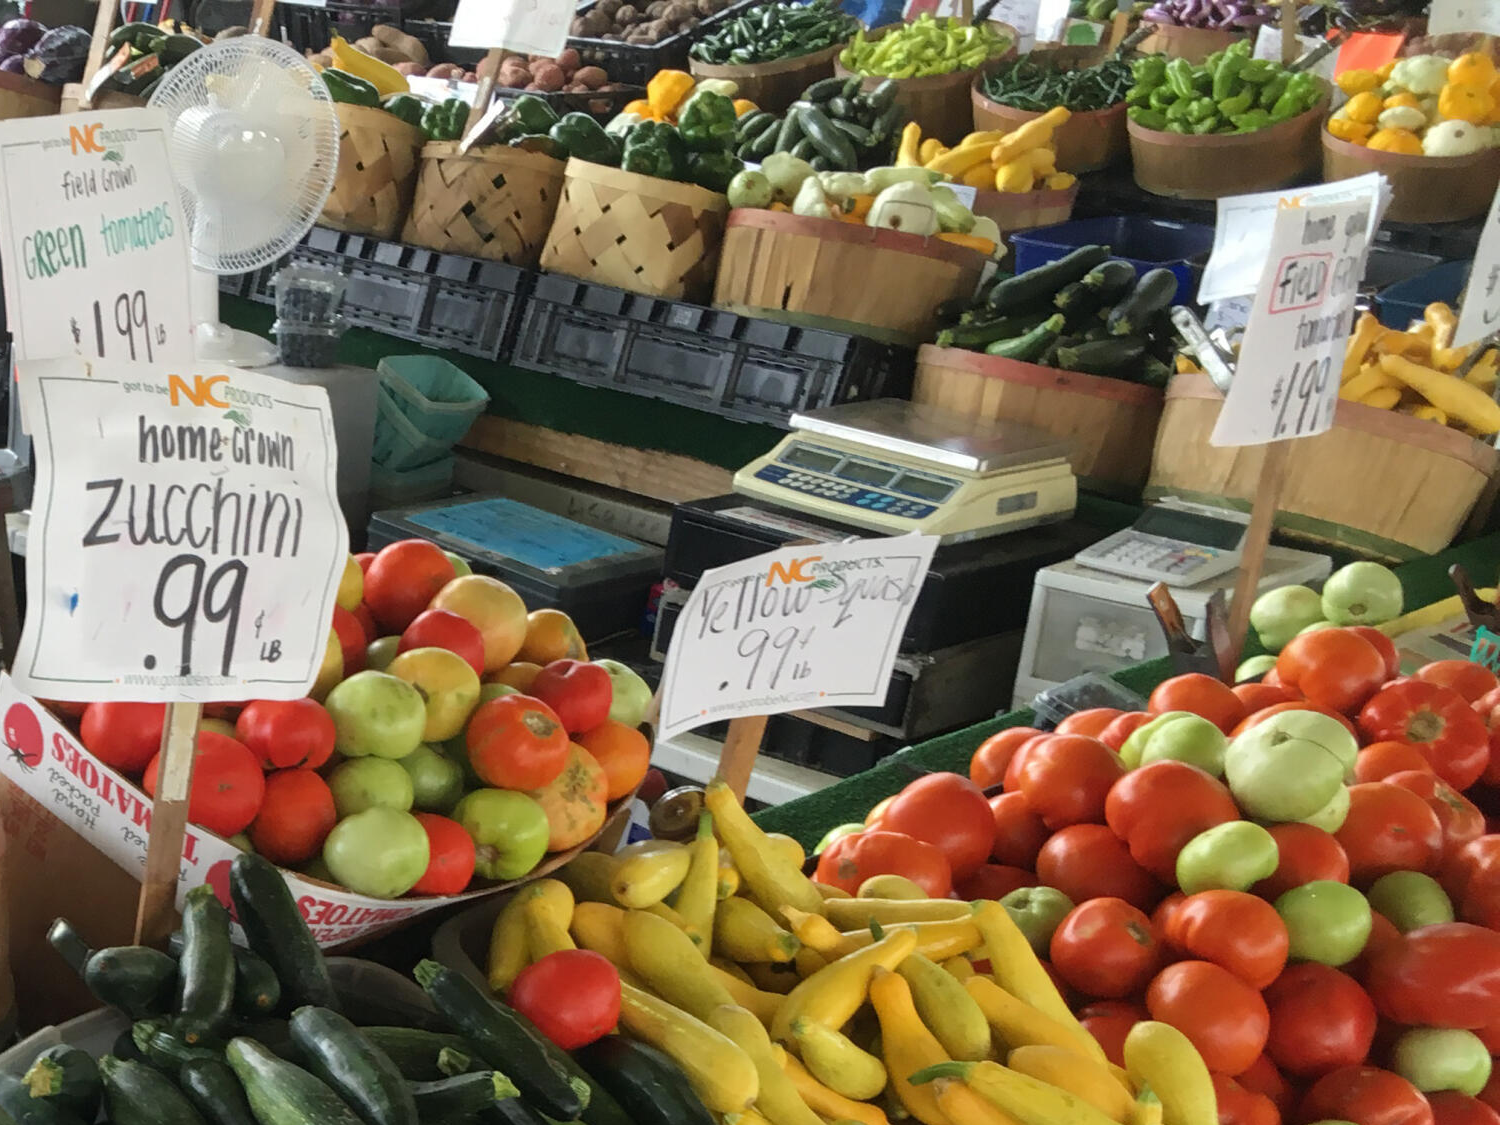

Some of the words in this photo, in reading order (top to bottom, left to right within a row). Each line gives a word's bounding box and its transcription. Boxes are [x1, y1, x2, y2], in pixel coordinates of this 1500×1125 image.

[69, 123, 107, 155] NC
[123, 381, 143, 394] got
[144, 383, 154, 394] to
[168, 375, 230, 408] NC
[224, 388, 274, 409] PRODUCTS
[765, 556, 824, 587] NC
[810, 557, 885, 576] PRODUCTS
[51, 732, 201, 867] TMATOES
